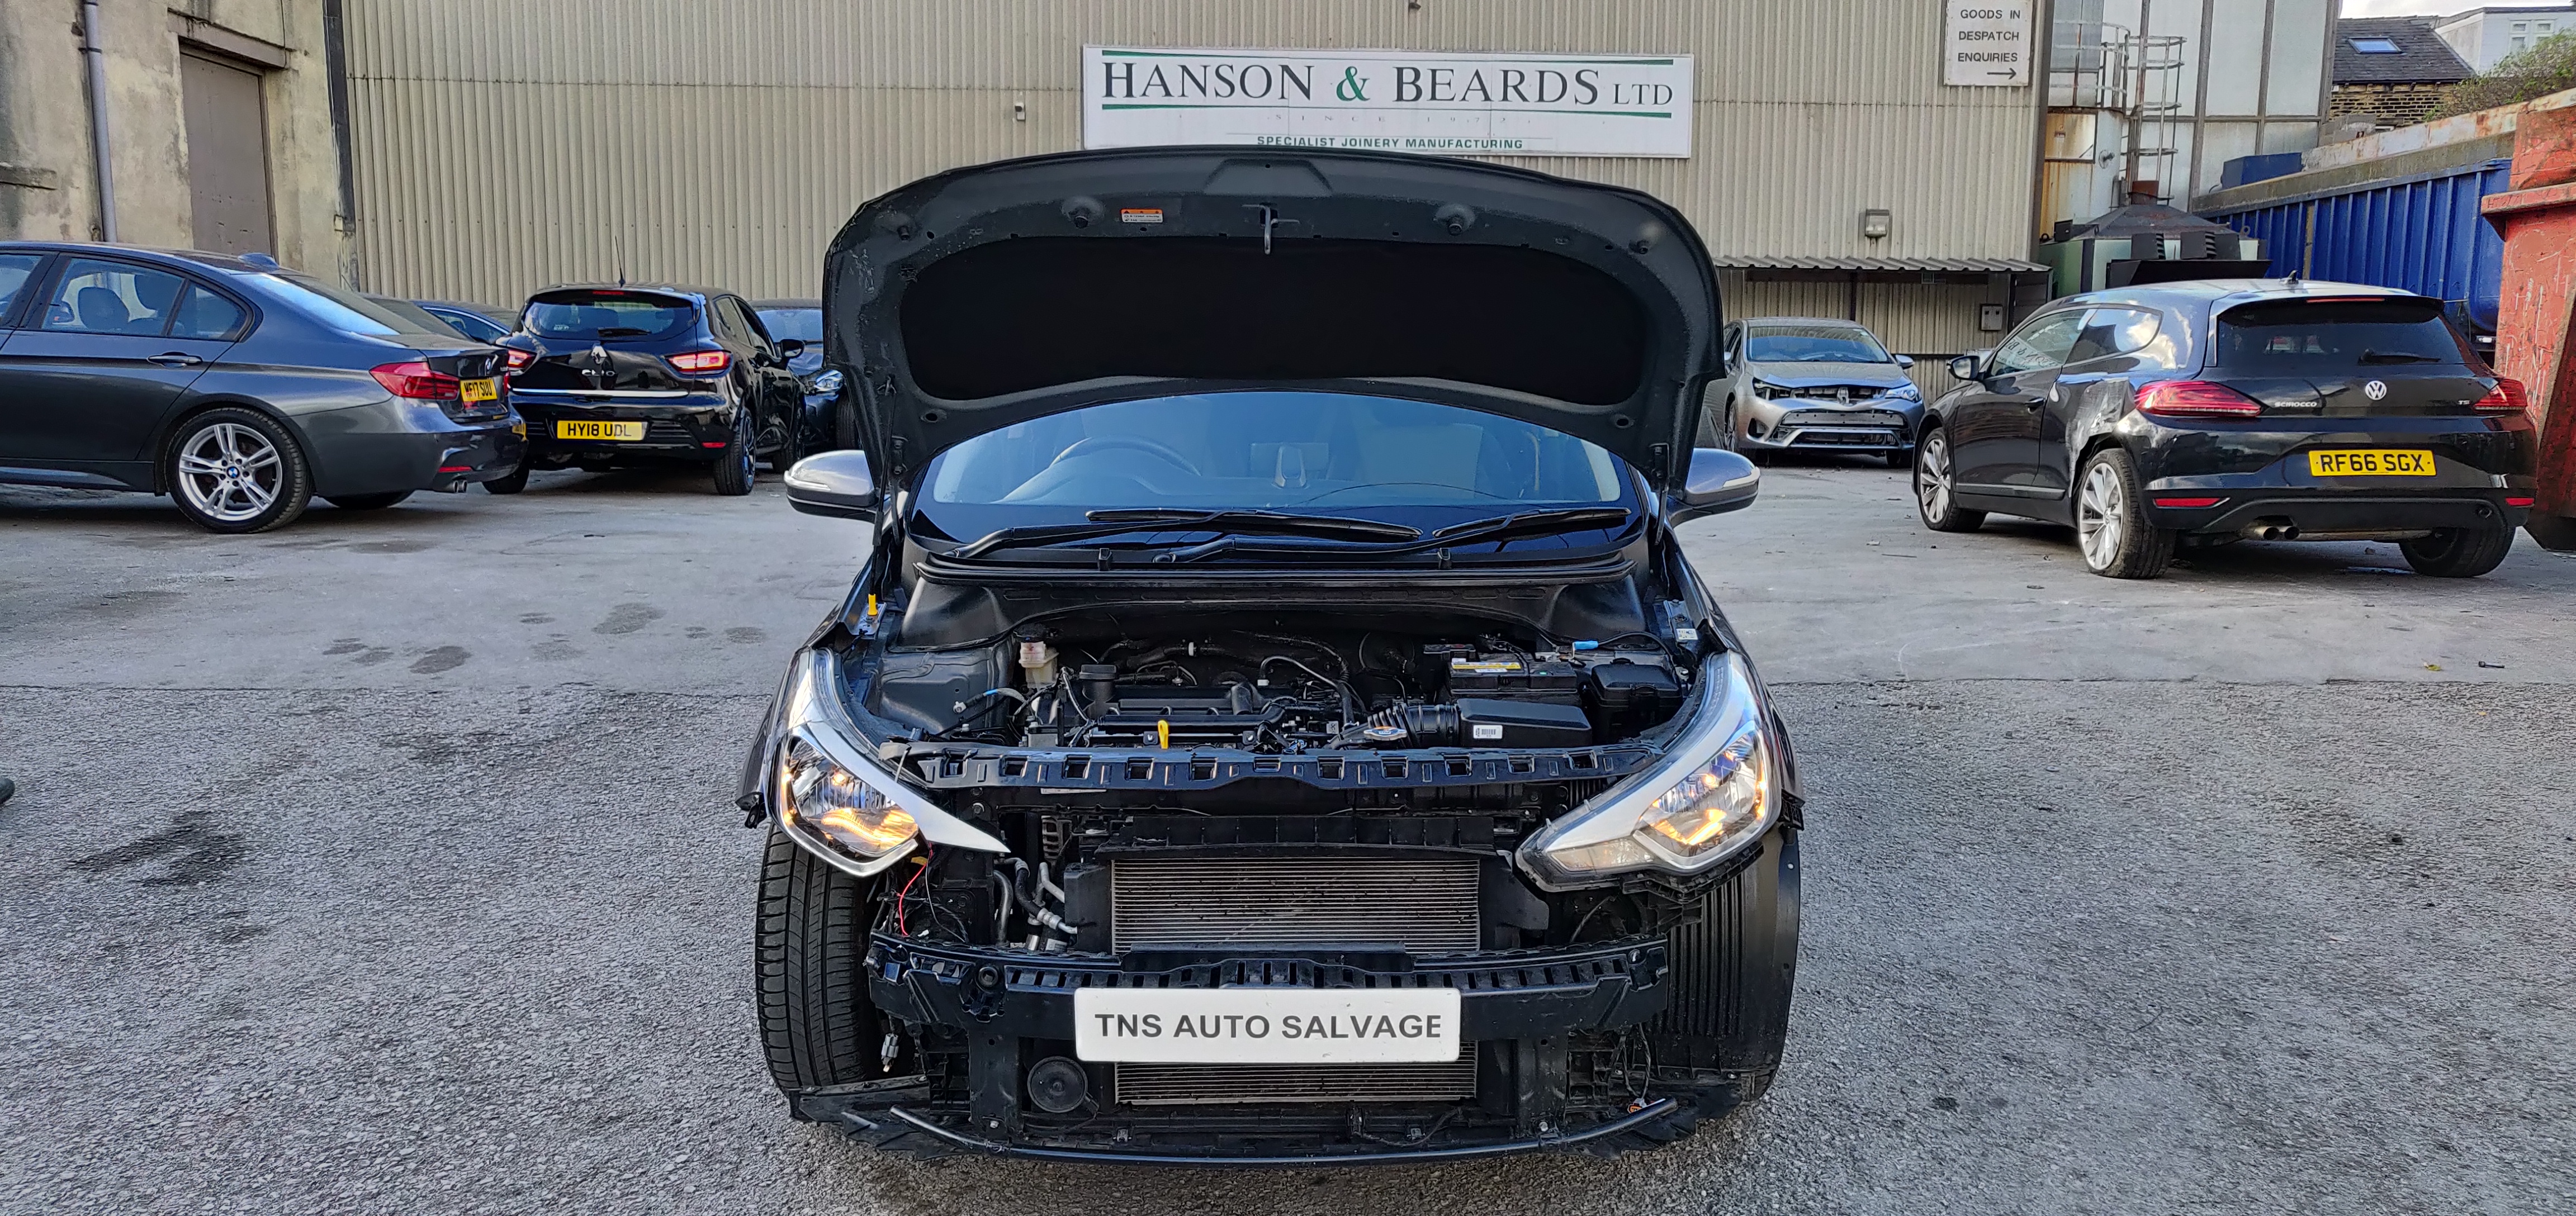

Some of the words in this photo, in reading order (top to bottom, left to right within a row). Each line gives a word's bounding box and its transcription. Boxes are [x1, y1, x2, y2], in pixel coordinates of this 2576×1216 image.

[1960, 9, 2002, 20] GOODS
[2010, 10, 2021, 19] IN
[1958, 31, 2019, 41] DESPATCH
[1958, 52, 2018, 63] ENQUIRIES
[1101, 61, 1314, 101] HANSON
[1336, 66, 1370, 102] &
[1393, 66, 1599, 105] BEARDS
[1612, 83, 1673, 105] LTD
[1257, 135, 1336, 148] SPECIALIST
[1341, 137, 1400, 148] JOINERY
[1405, 139, 1523, 150] MANUFACTURING
[567, 422, 600, 436] HY18
[604, 424, 632, 437] UDL
[2320, 454, 2378, 472] RF66
[2383, 454, 2425, 472] SGX
[1095, 1014, 1162, 1038] TNS
[1173, 1015, 1270, 1038] AUTO
[1282, 1015, 1441, 1039] SALVAGE
